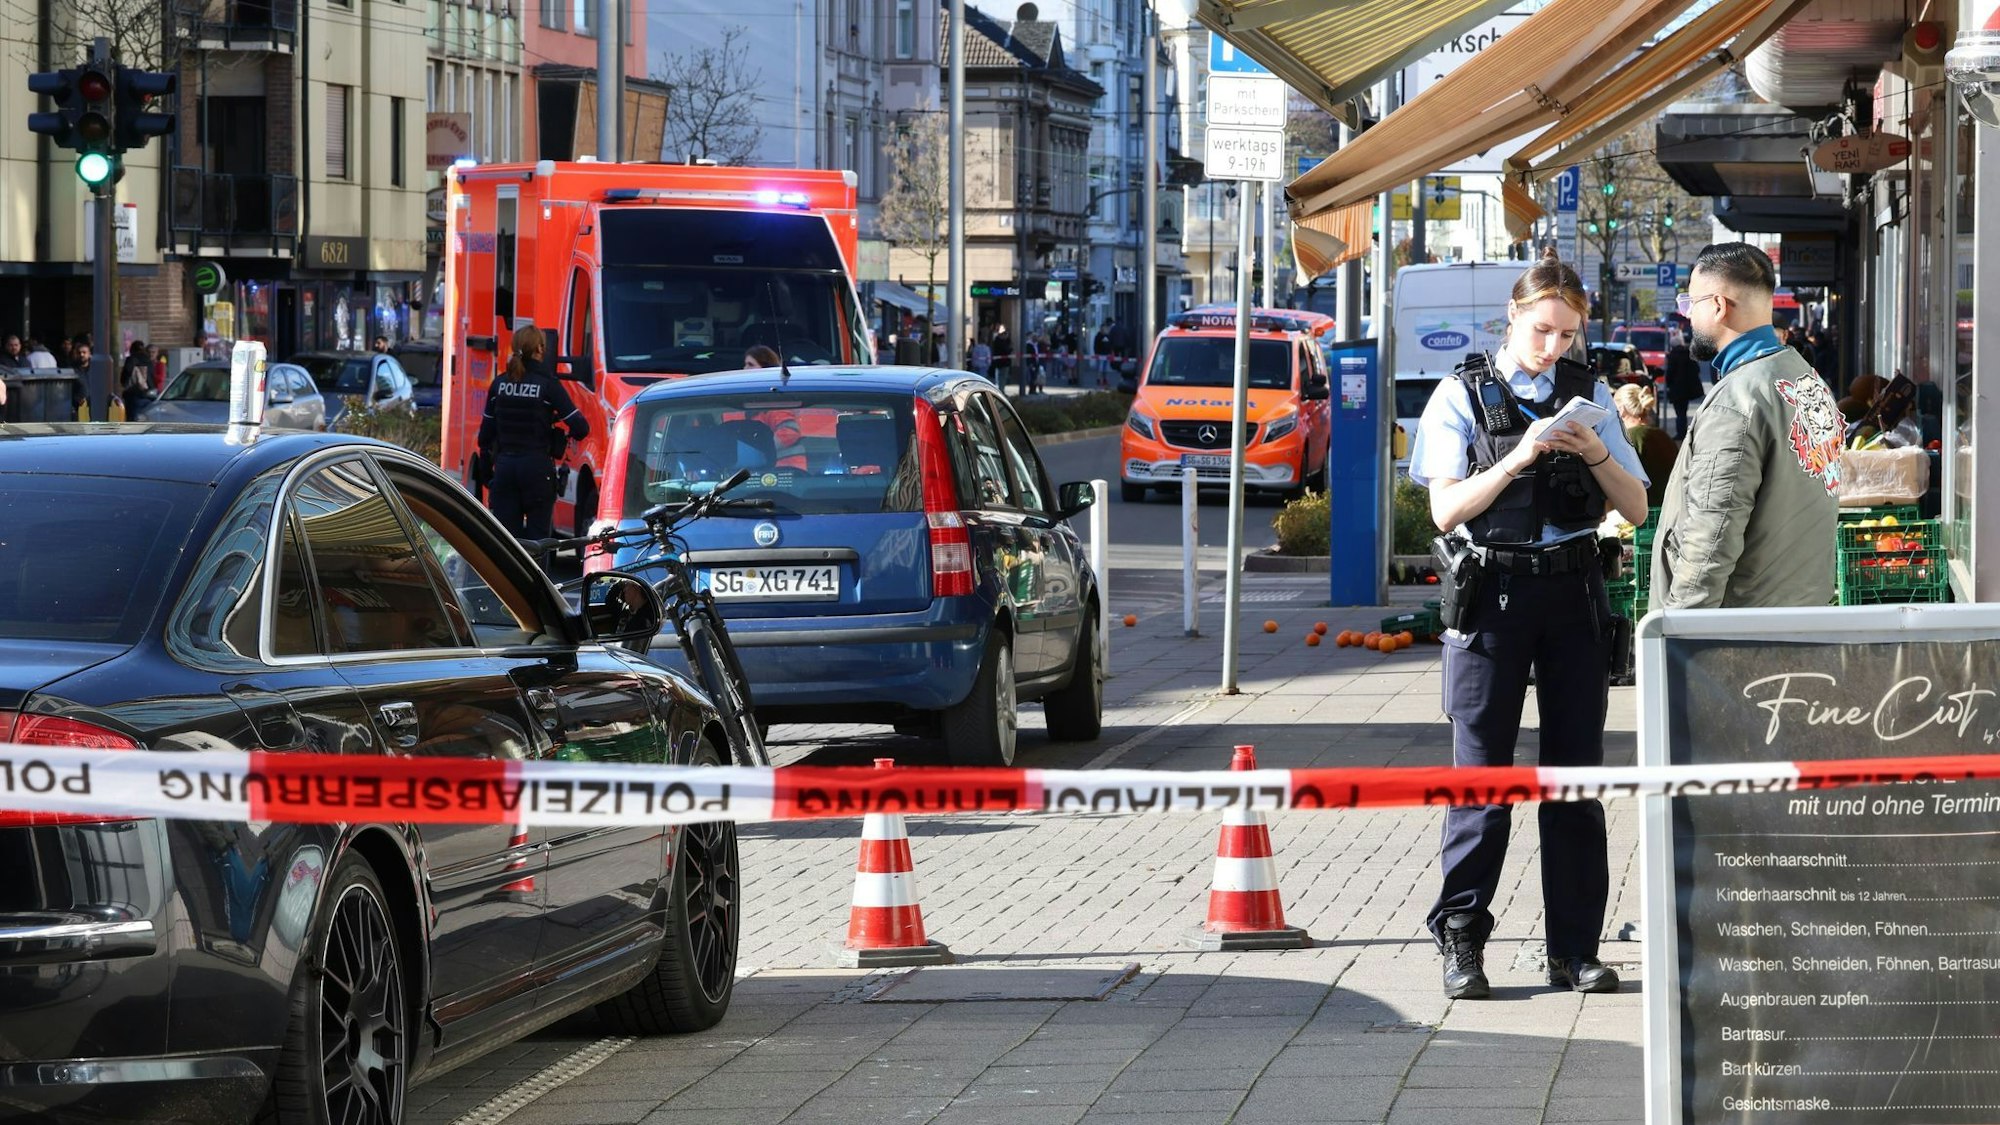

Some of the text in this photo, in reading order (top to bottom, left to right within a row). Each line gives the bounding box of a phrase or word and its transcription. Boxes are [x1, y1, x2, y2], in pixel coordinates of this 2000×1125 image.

[1237, 89, 1256, 100] mit
[1213, 102, 1280, 116] Parkschein
[1213, 138, 1278, 156] werktags
[321, 241, 349, 264] 6821
[1202, 315, 1258, 327] NOTAT
[498, 382, 541, 398] POLIZEI
[1165, 398, 1258, 408] Notart
[758, 530, 775, 540] FIAT
[714, 568, 836, 593] SG XG 741
[1743, 672, 1997, 746] Fine Cut
[159, 768, 731, 815] POLIZEIABSPERRUNG
[1788, 792, 2000, 815] mit und ohne Termin
[1714, 852, 1848, 868] Trockenhaarschnitt
[1716, 886, 1837, 902] Kinderhaarschnit
[1840, 891, 1856, 902] bis
[1857, 892, 1870, 902] 12
[1717, 921, 1787, 937] Waschen,
[1791, 921, 1871, 937] Schneiden,
[1718, 957, 1788, 973] Waschen,
[1792, 956, 1872, 973] Schneiden,
[1876, 956, 1934, 972] Föhnen,
[1720, 992, 1816, 1009] Augenbrauen
[1721, 1061, 1752, 1076] Bart
[1722, 1096, 1831, 1111] Gesichtsmaske
